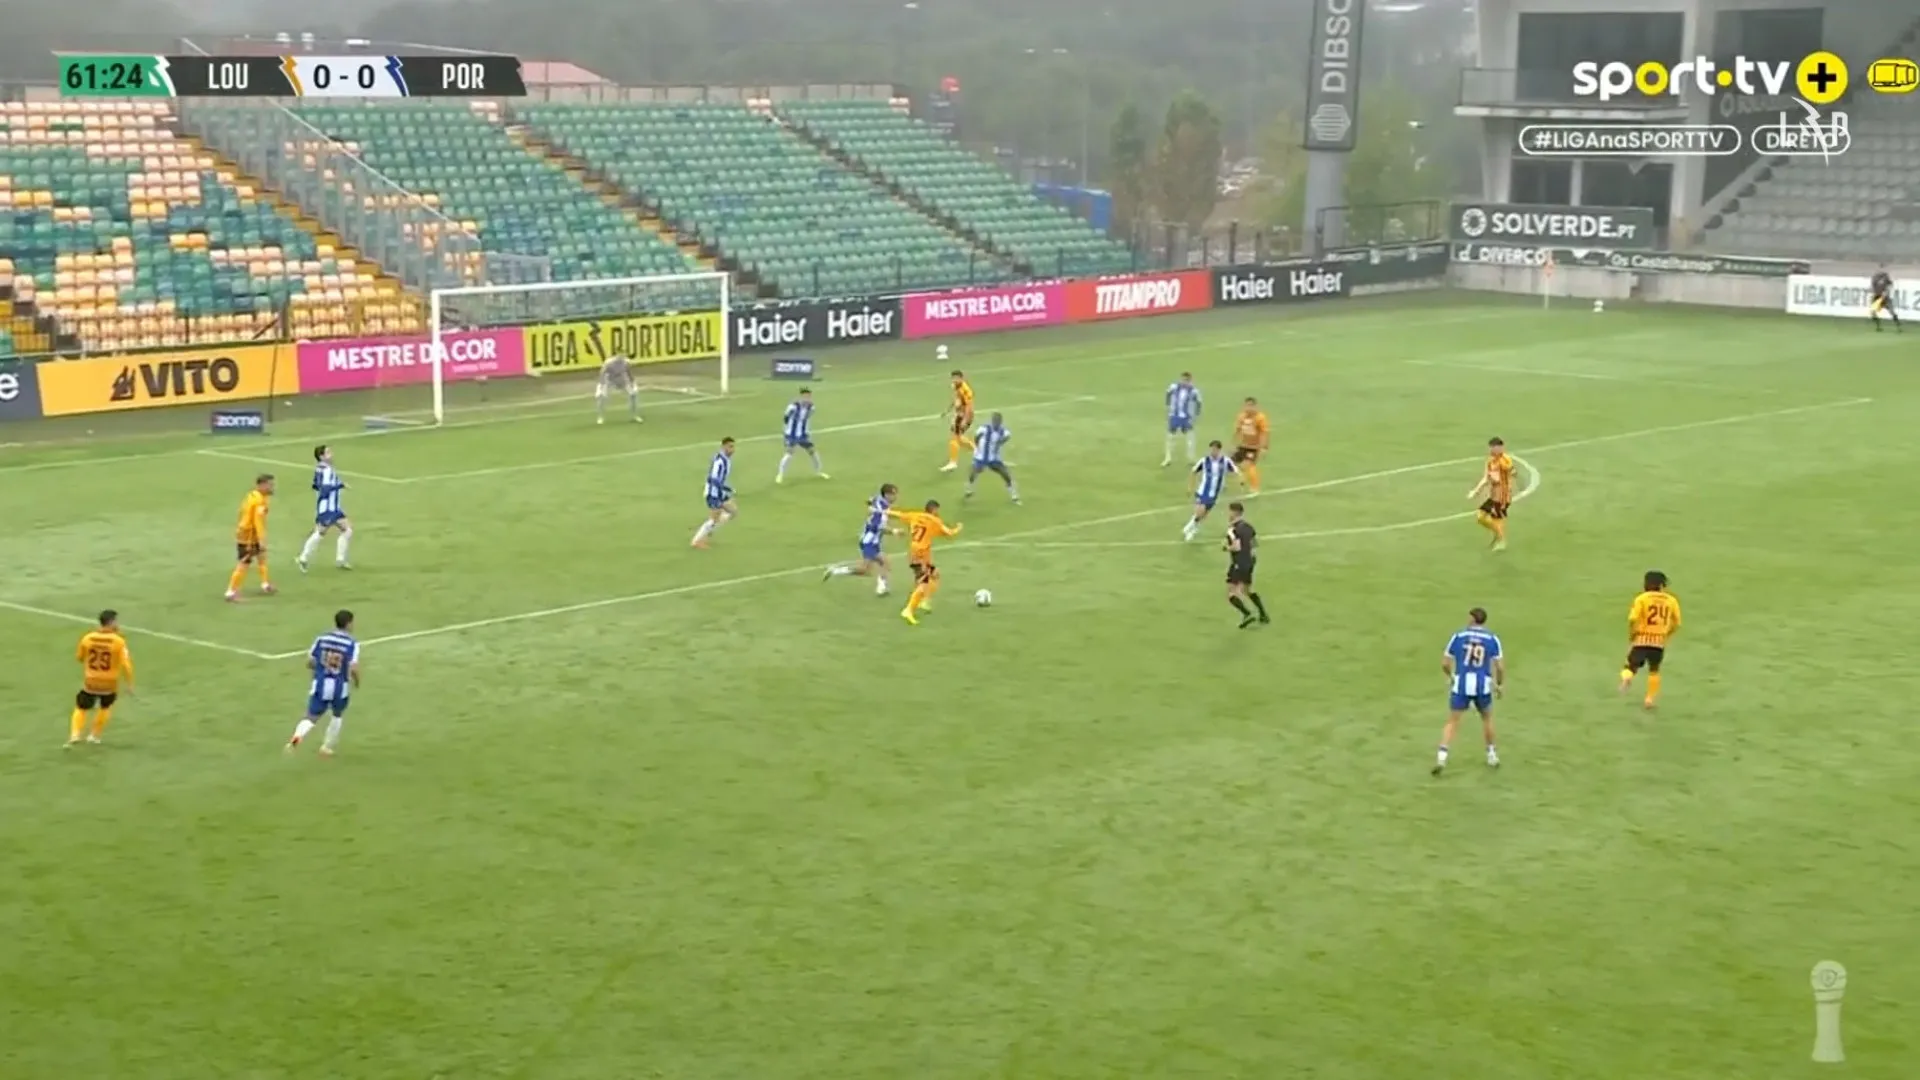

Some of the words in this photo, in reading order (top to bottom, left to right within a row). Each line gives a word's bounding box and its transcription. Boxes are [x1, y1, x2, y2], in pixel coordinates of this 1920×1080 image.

[1491, 212, 1636, 239] SOLVERDE.PT
[1096, 278, 1181, 313] TITANPRO
[1221, 275, 1275, 300] Haier
[1290, 268, 1342, 296] Haier
[1794, 284, 1826, 304] LIGA
[925, 298, 988, 319] MESTRE
[990, 295, 1012, 314] DA
[1013, 292, 1046, 311] COR
[737, 316, 807, 346] Haier
[827, 308, 893, 338] Haier
[327, 343, 416, 371] MESTRE
[451, 338, 497, 361] COR
[531, 330, 579, 368] LIGA
[610, 319, 717, 358] PORTUGAL
[139, 358, 240, 397] VITO
[216, 413, 262, 428] zome
[1646, 605, 1669, 625] 24
[88, 648, 111, 671] 29
[1462, 643, 1485, 668] 79
